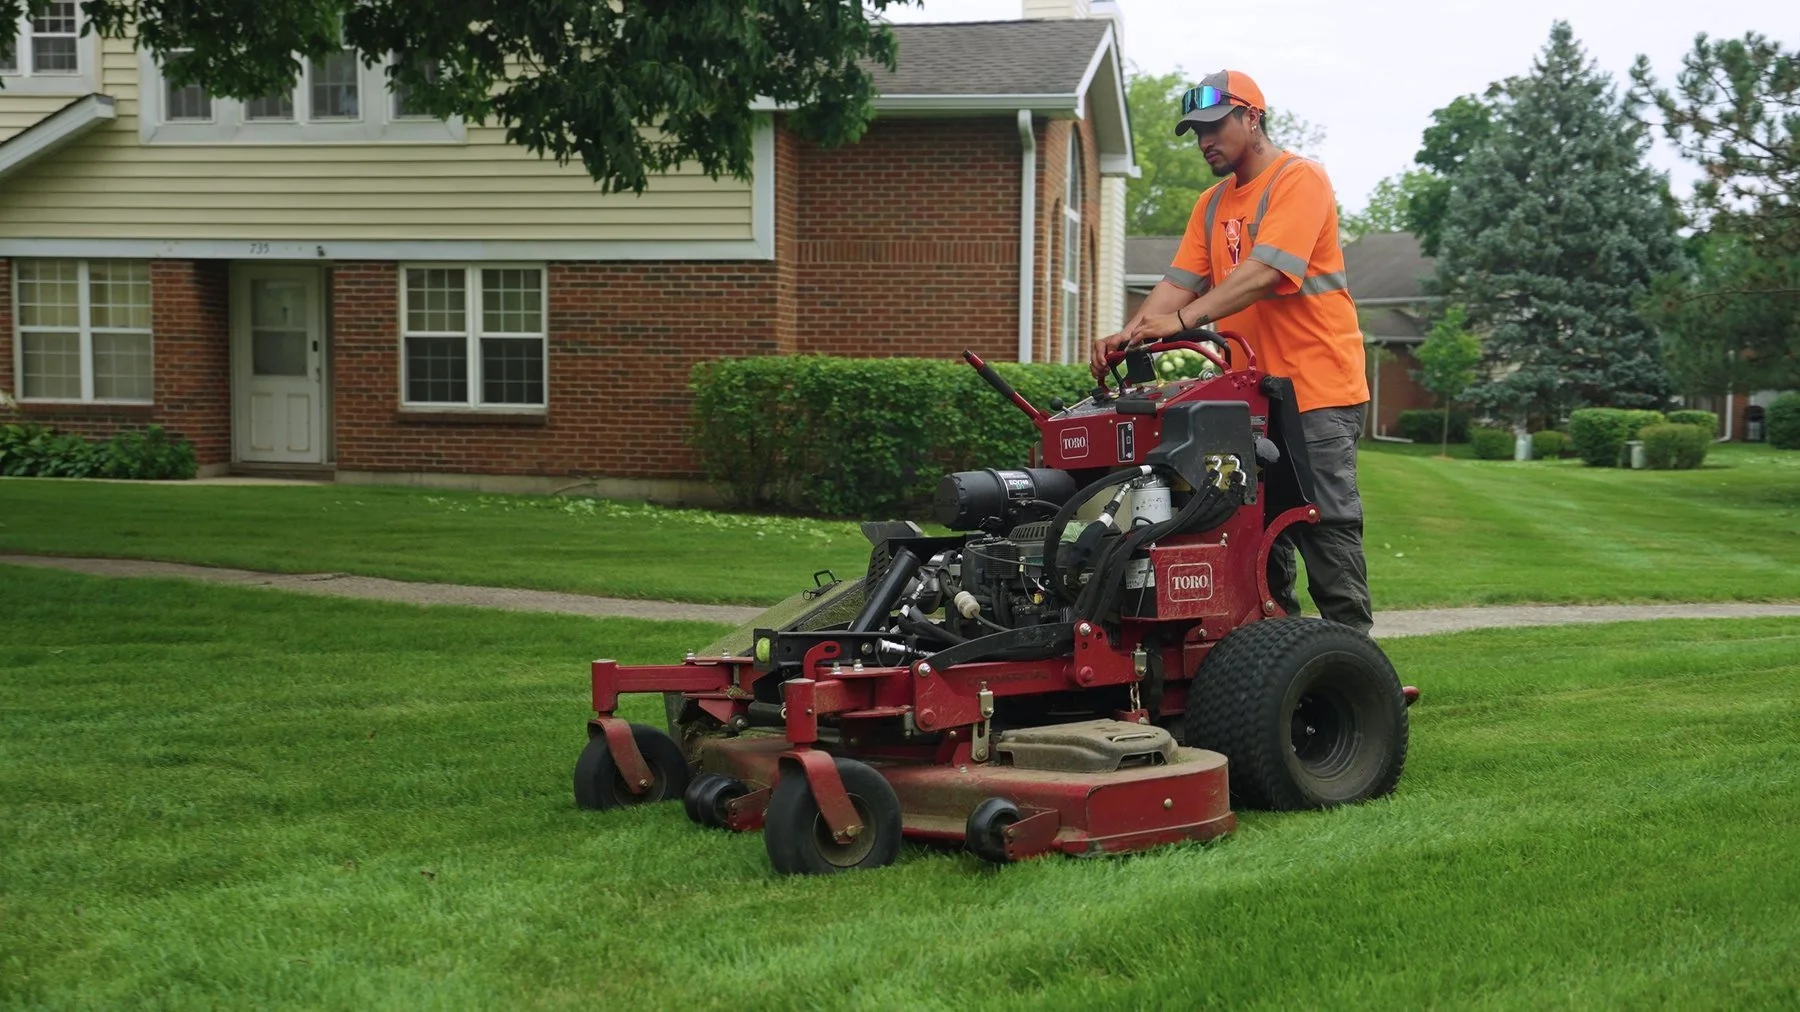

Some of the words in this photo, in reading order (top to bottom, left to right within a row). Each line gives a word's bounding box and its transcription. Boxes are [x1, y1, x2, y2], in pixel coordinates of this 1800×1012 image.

[250, 243, 270, 254] 735
[1063, 436, 1086, 449] TORO
[1171, 575, 1209, 590] TORO
